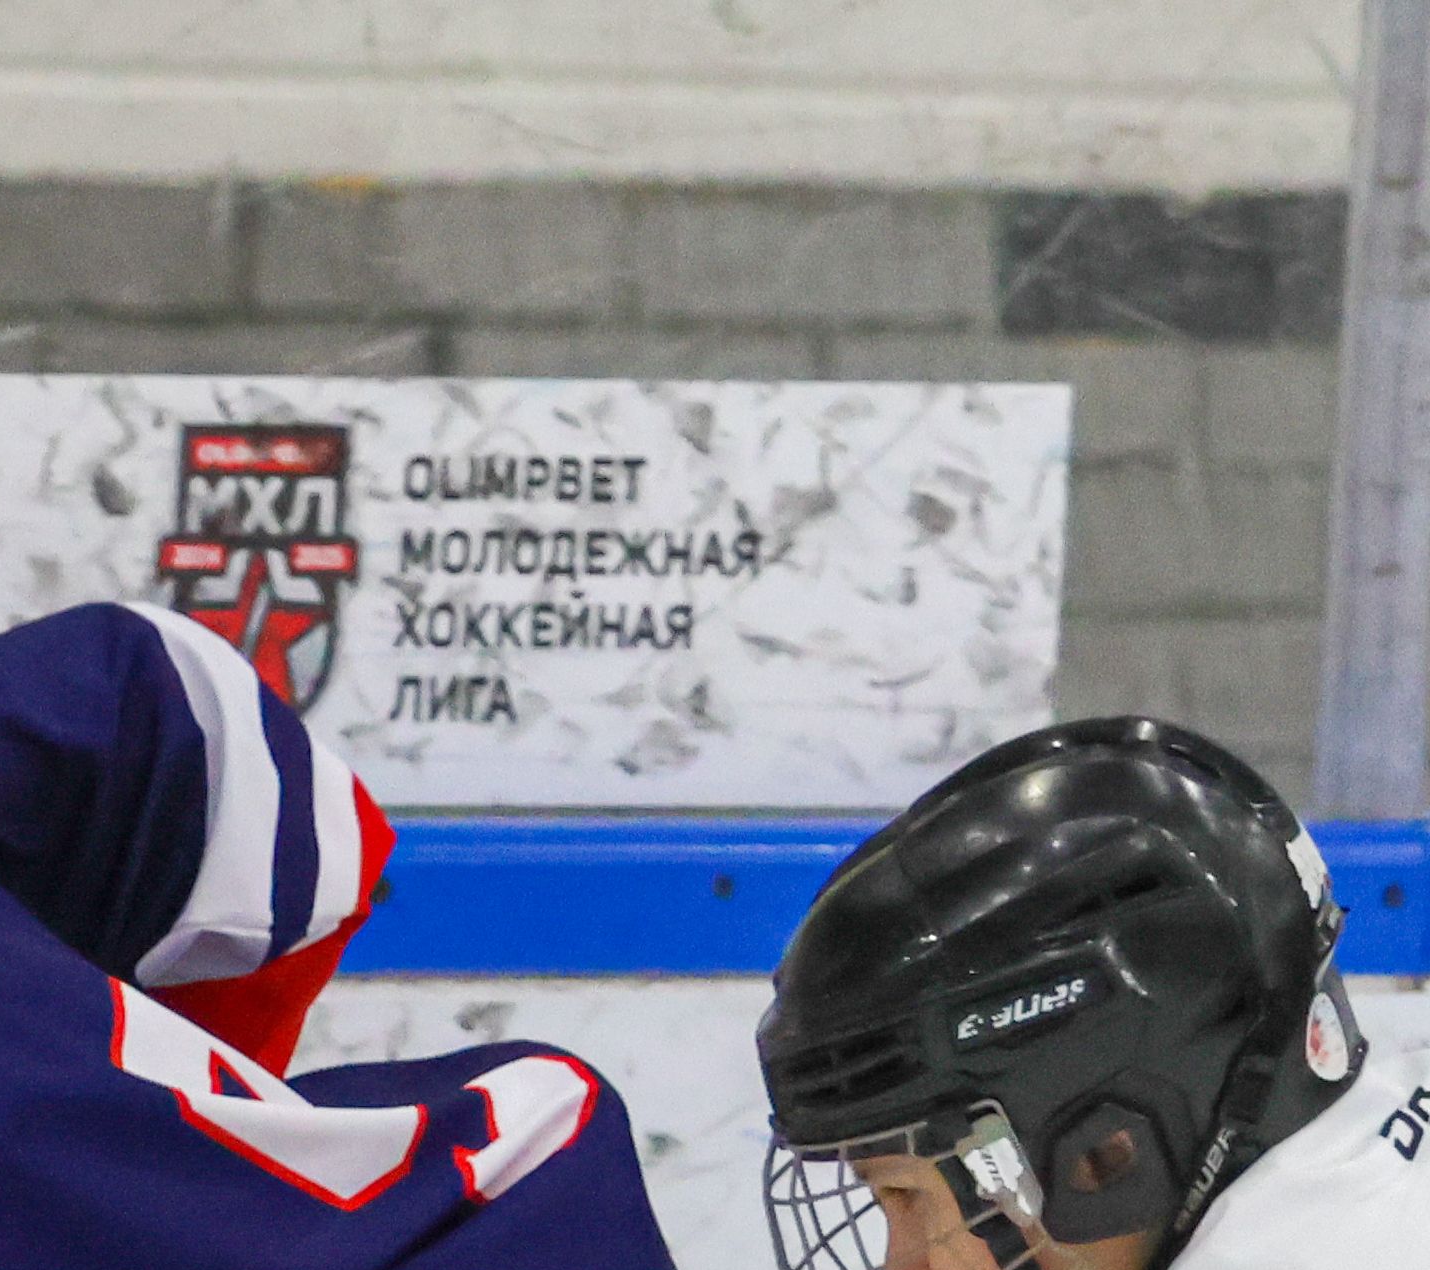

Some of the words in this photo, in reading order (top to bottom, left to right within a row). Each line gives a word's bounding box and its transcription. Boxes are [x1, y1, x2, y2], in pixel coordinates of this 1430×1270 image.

[404, 456, 646, 500] OLIMPBET
[400, 528, 764, 583] МОЛОДЕЖНАЯ
[393, 589, 695, 649] ХОККЕЙНАЯ
[390, 676, 517, 724] ЛИГА
